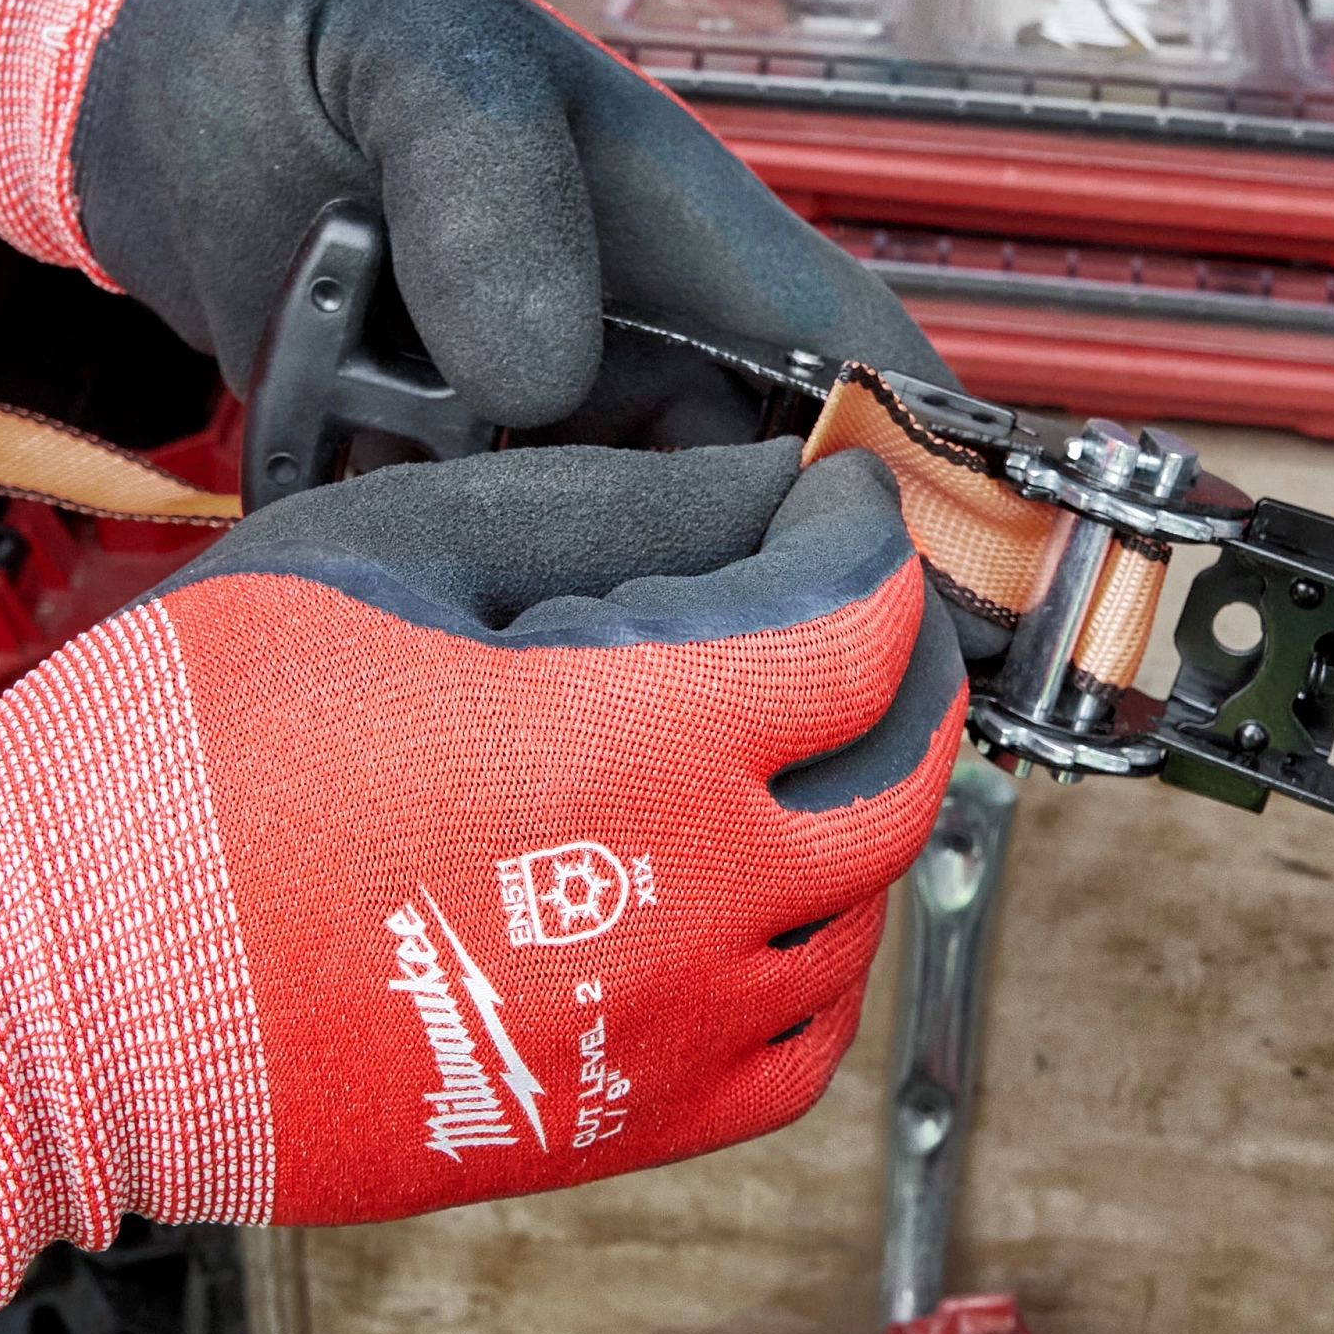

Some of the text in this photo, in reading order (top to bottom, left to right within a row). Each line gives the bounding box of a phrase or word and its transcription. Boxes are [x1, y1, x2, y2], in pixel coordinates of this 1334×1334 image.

[496, 858, 533, 948] EN511
[632, 852, 657, 907] X1X
[383, 903, 521, 1164] Milwaukee
[572, 979, 606, 1148] CUT LEVEL 2
